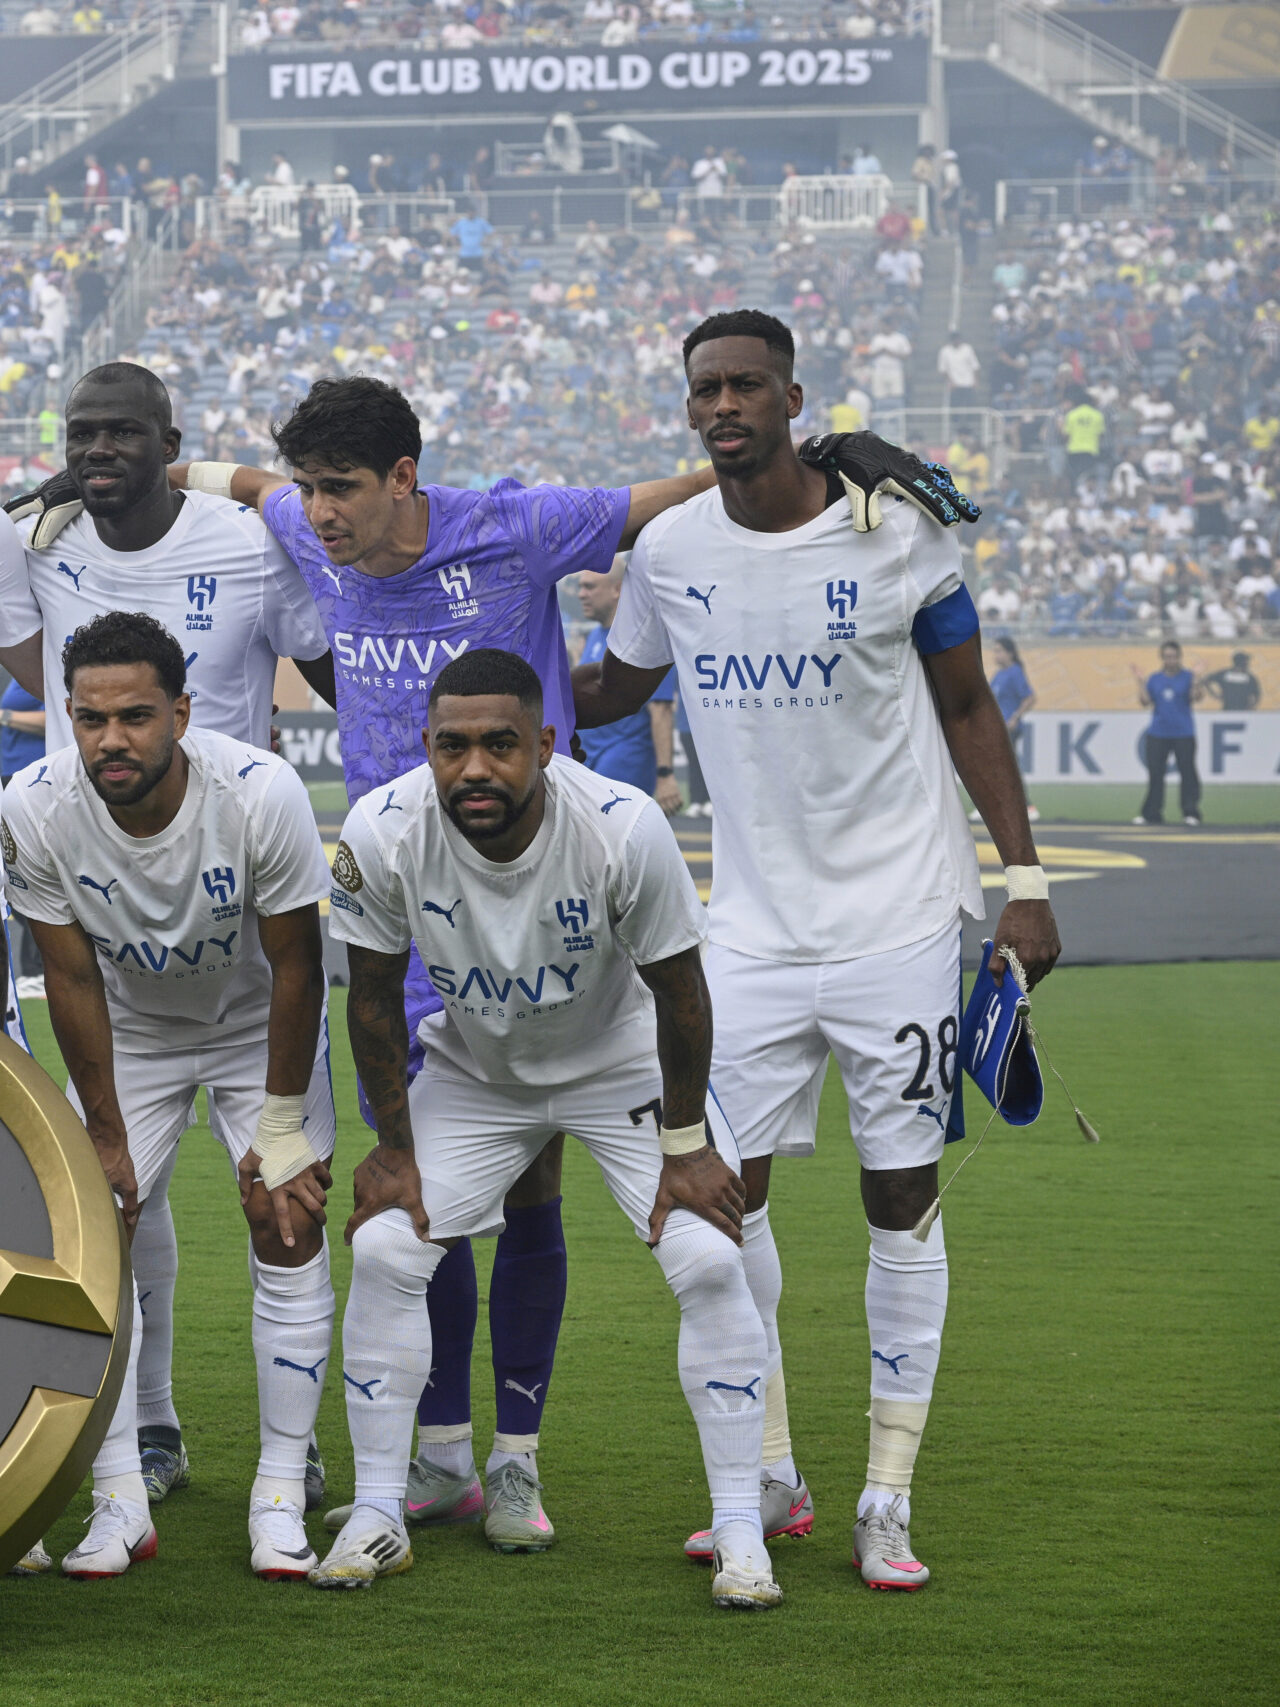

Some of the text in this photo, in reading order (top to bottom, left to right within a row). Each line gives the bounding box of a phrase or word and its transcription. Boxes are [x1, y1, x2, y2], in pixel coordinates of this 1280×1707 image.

[270, 62, 362, 99] FIFA
[369, 57, 481, 96] CLUB
[489, 54, 652, 93] WORLD
[660, 51, 751, 89] CUP
[186, 613, 213, 622] ALHILAL
[449, 598, 479, 611] ALHILAL
[827, 622, 857, 631] ALHILAL
[334, 631, 470, 674] SAVVY
[342, 670, 396, 689] GAMES
[694, 653, 842, 691] SAVVY
[702, 693, 843, 709] GAMES GROUP
[87, 930, 238, 972] SAVVY
[175, 960, 232, 979] GROU
[428, 962, 580, 1004] SAVVY
[449, 989, 586, 1019] AMES GROUP
[894, 1015, 958, 1101] 28
